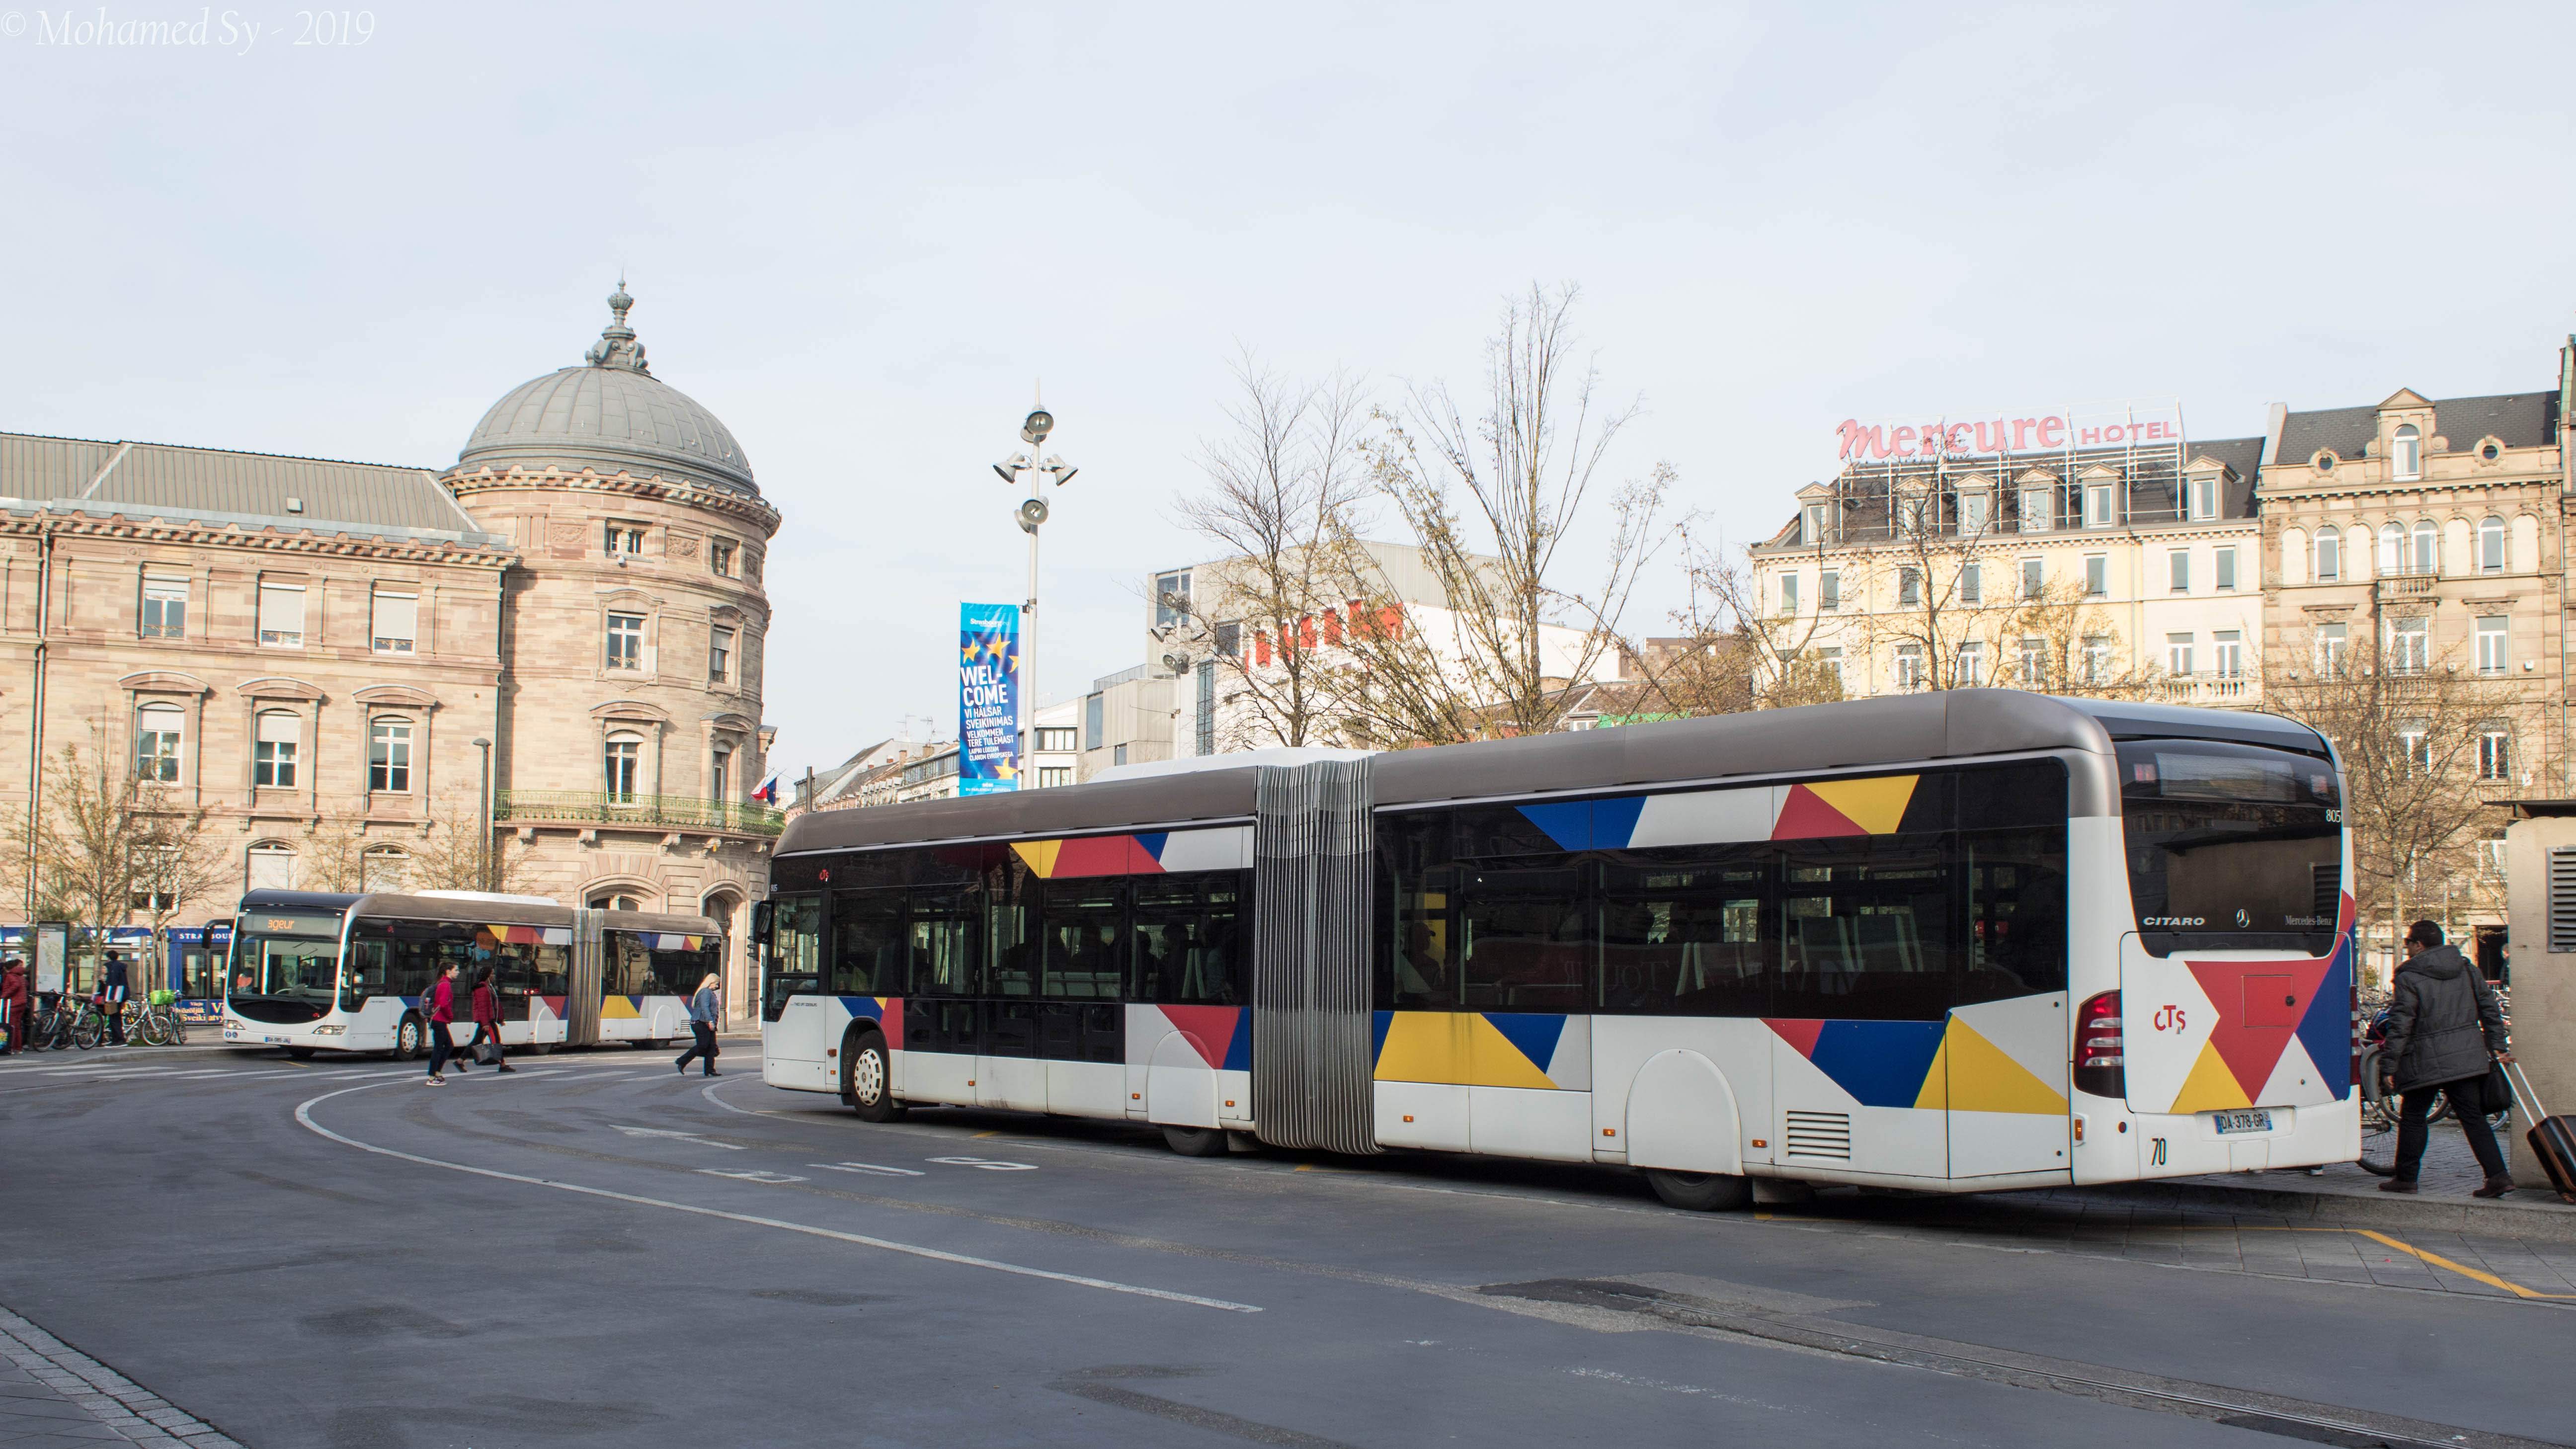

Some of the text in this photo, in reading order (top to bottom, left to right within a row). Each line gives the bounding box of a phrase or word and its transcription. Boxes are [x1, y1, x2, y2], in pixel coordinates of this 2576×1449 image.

[2081, 421, 2178, 445] HOTEL
[961, 665, 1003, 686] WEL-
[963, 684, 1009, 707] COME
[965, 706, 1003, 719] VI HÄLSAR
[966, 716, 1014, 729] SVEIKINIMAS
[966, 728, 1004, 739] VELKOMMEN
[967, 735, 1014, 747] TERE TULEMAST
[2325, 808, 2341, 823] 805
[267, 919, 295, 931] ageur
[2143, 914, 2333, 926] CITARO Mercedes-Benz
[2154, 1005, 2186, 1031] CTS
[2220, 1113, 2265, 1129] DA-378-GR
[2151, 1137, 2167, 1166] 70
